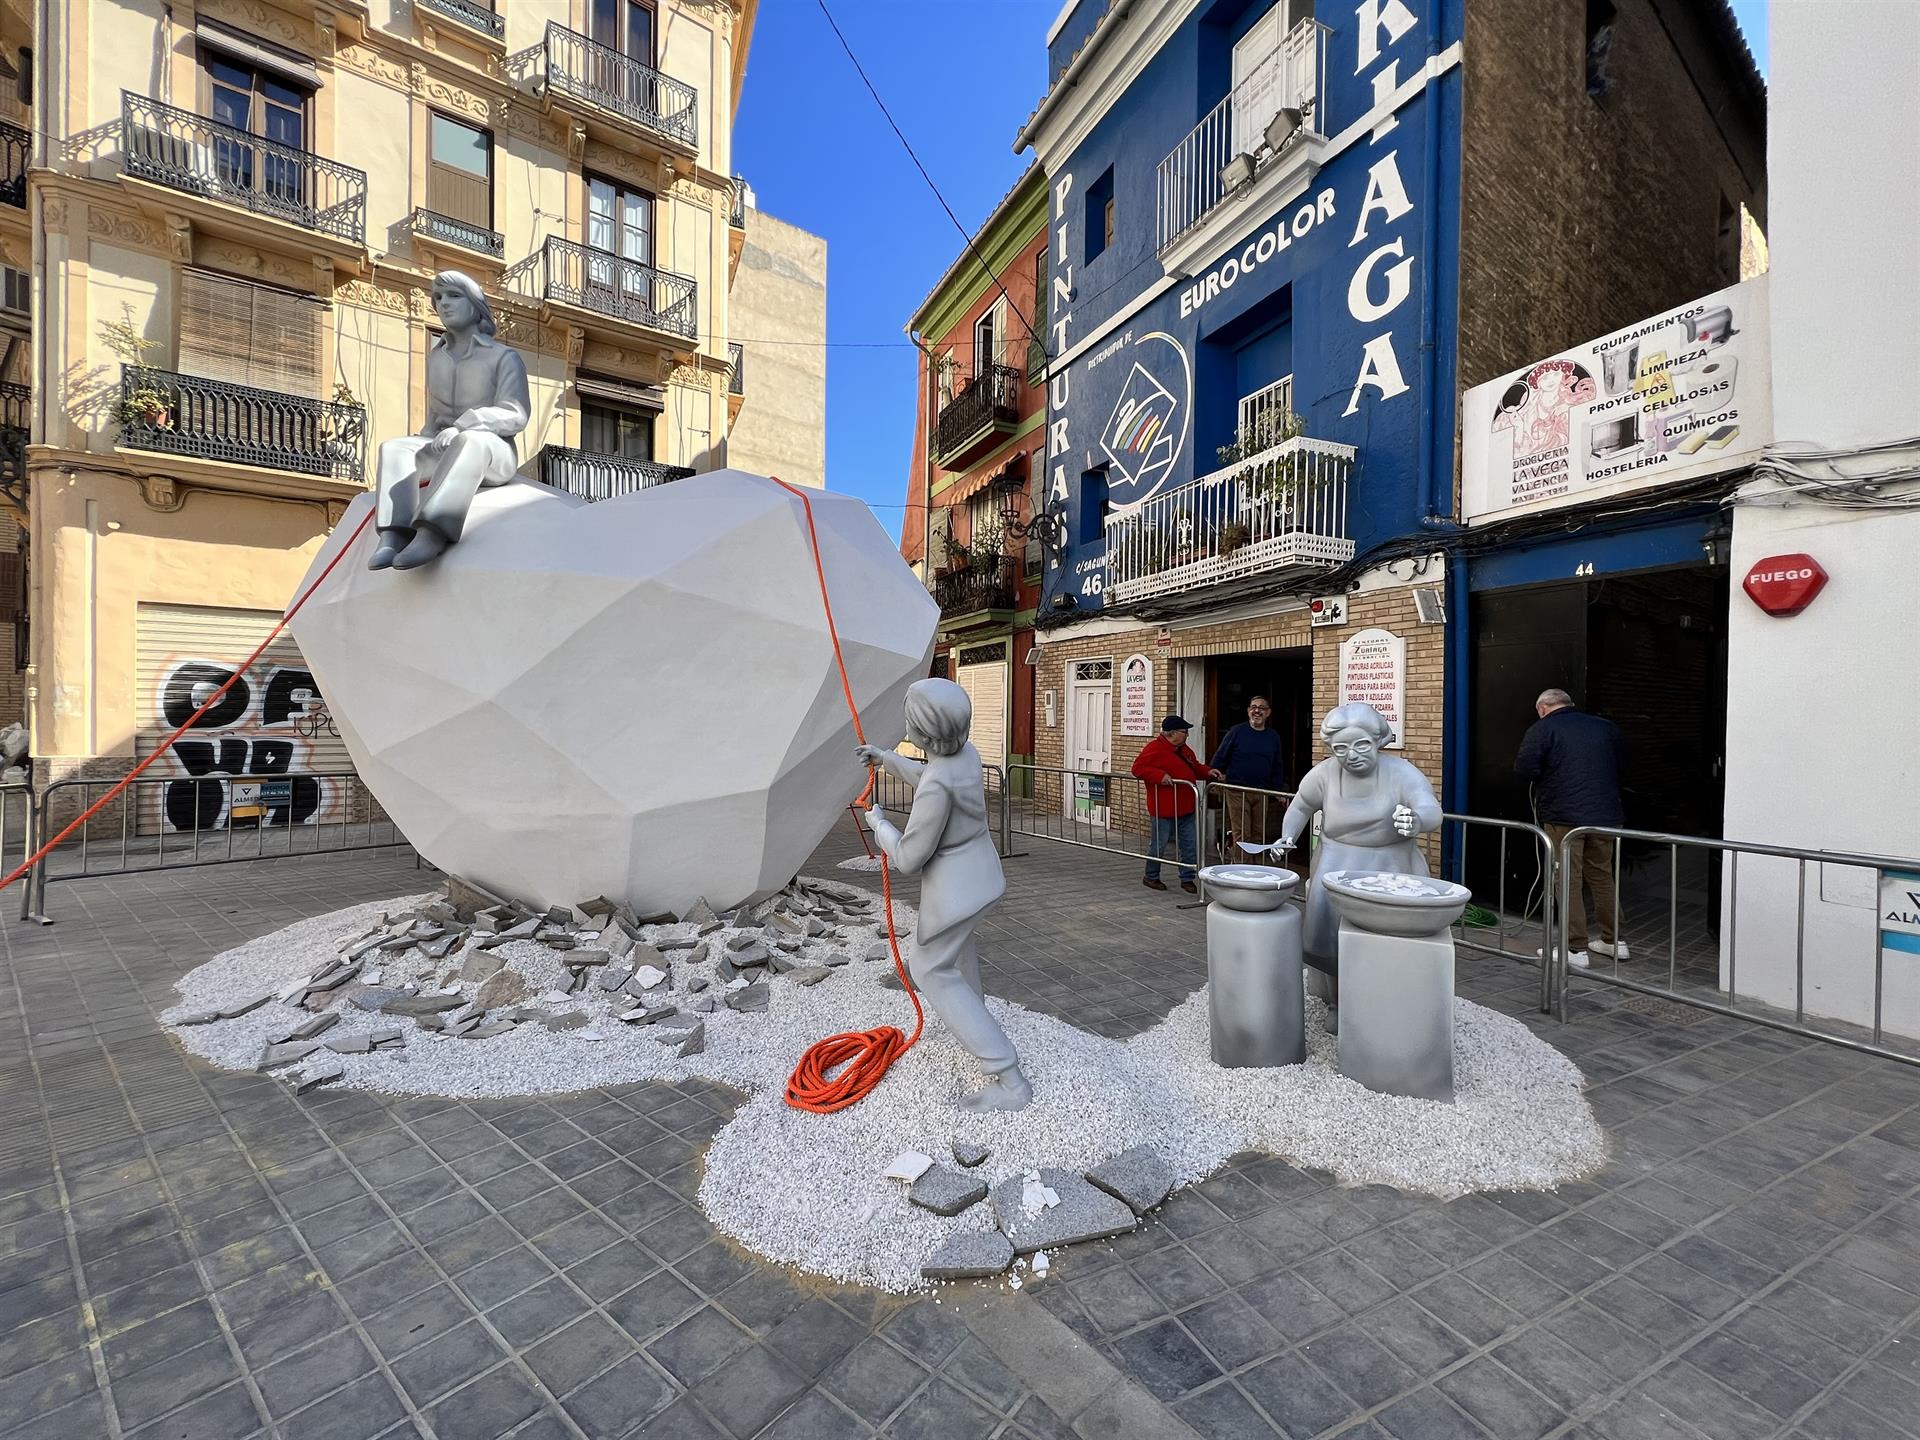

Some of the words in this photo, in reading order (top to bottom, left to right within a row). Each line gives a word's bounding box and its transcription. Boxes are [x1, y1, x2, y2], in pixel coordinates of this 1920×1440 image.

[1180, 187, 1337, 320] EUROCOLOR
[1592, 305, 1705, 354] EQUIPAMIENTOS
[1640, 349, 1707, 378] LIMPIEZA
[1589, 383, 1669, 415] PROYECTOS
[1642, 380, 1729, 413] CELULOSAS
[1662, 410, 1739, 437] QUIMICOS
[1512, 446, 1569, 469] DROGUERIA
[1512, 468, 1528, 483] LA
[1530, 458, 1569, 478] VEGA
[1586, 454, 1669, 481] HOSTELERIA
[1511, 473, 1569, 494] VALENCIA
[1575, 562, 1594, 577] 44
[1750, 568, 1813, 585] FUEGO
[1081, 573, 1102, 597] 46
[1348, 693, 1364, 701] SUELOS
[1369, 693, 1392, 701] AZULEJOS
